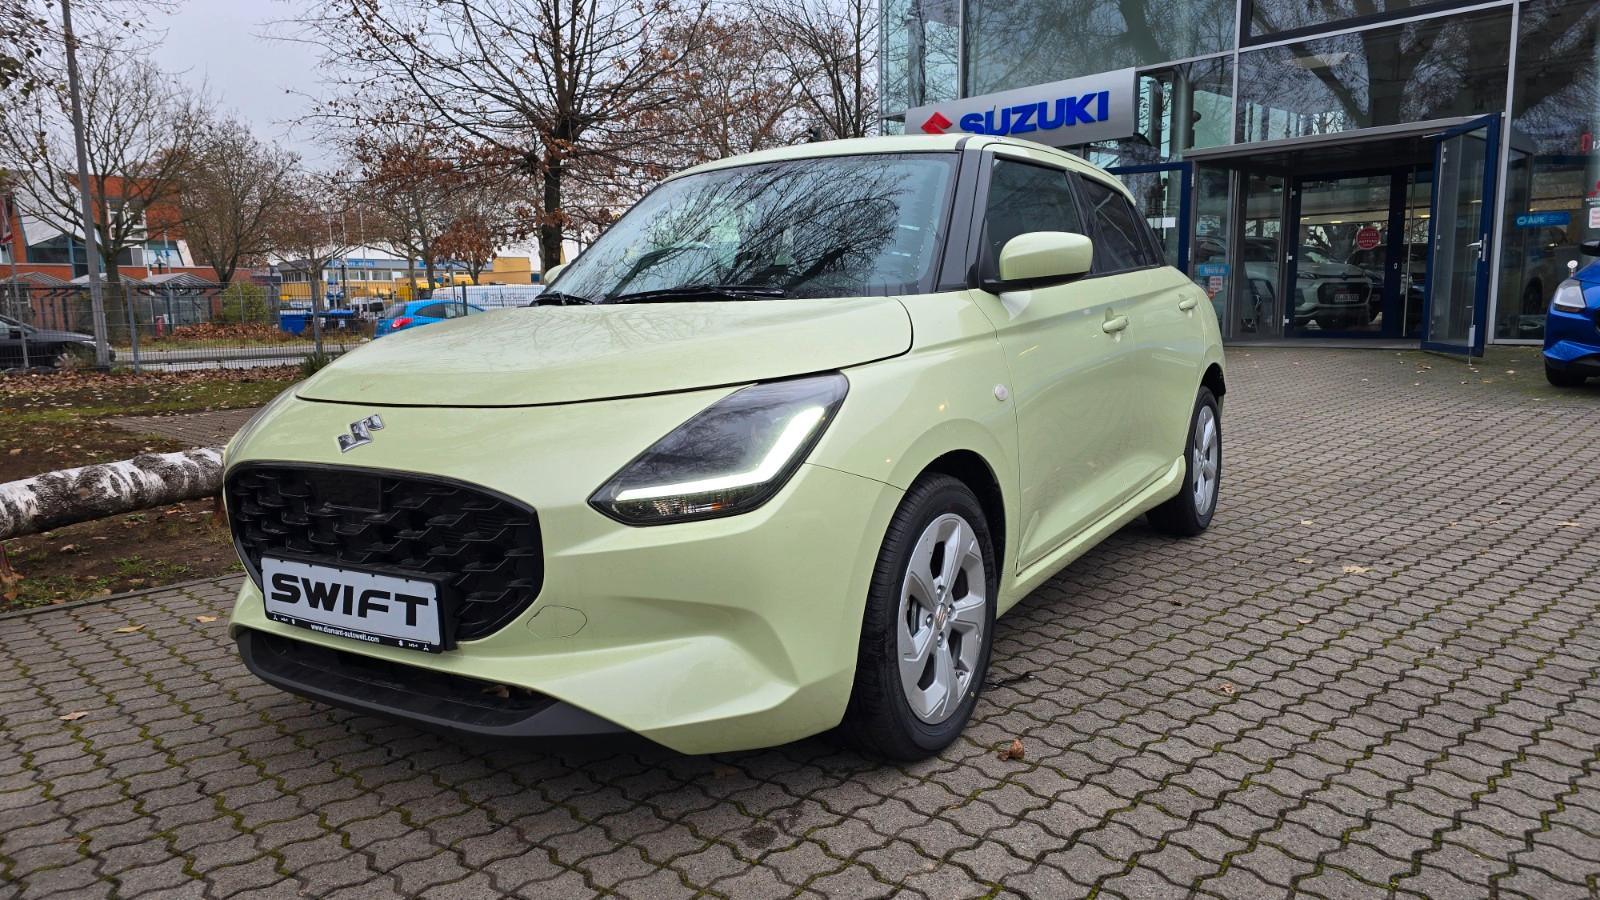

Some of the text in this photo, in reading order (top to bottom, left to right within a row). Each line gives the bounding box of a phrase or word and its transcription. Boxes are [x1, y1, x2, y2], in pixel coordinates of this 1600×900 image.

[959, 91, 1110, 135] SUZUKI
[271, 573, 429, 627] SWIFT
[310, 623, 380, 643] www.diamant-autowelt.com
